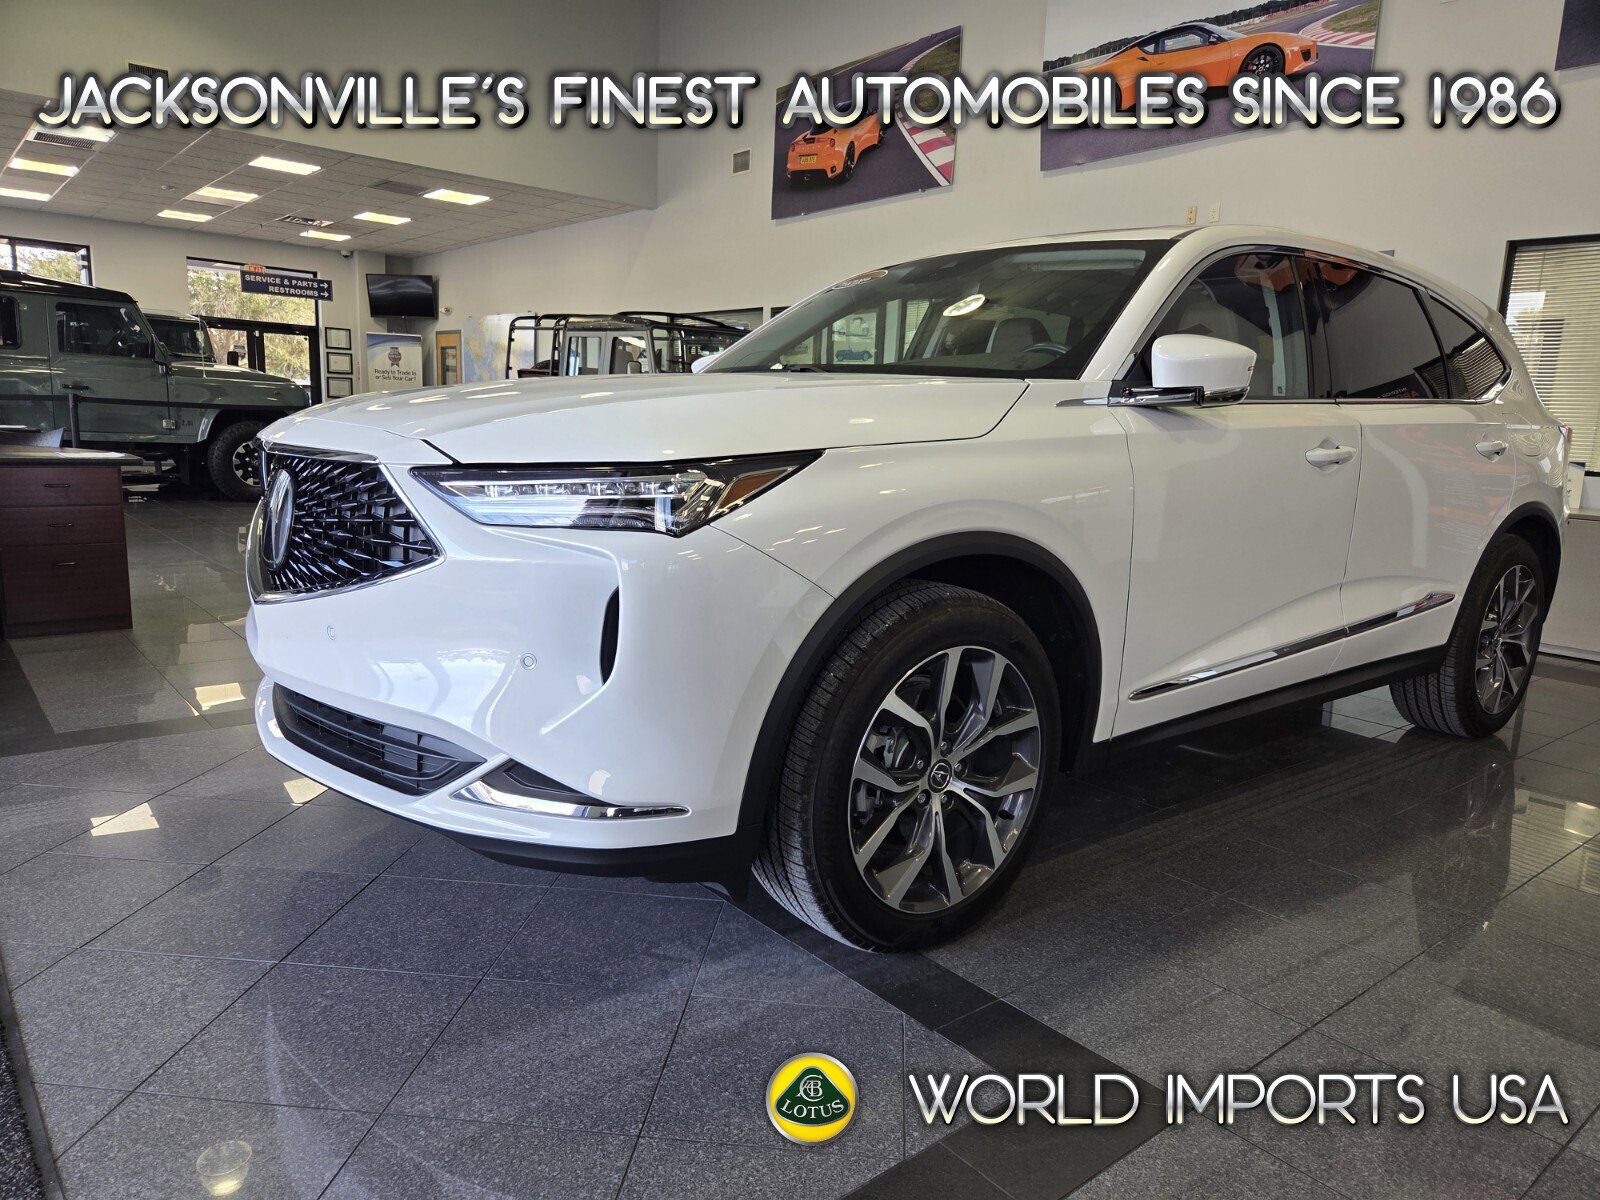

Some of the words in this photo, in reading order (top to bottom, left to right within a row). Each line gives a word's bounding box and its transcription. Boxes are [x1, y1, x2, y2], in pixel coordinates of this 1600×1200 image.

[245, 275, 281, 284] SERVICE
[292, 280, 318, 288] PARTS
[268, 286, 318, 296] RESTROOMS
